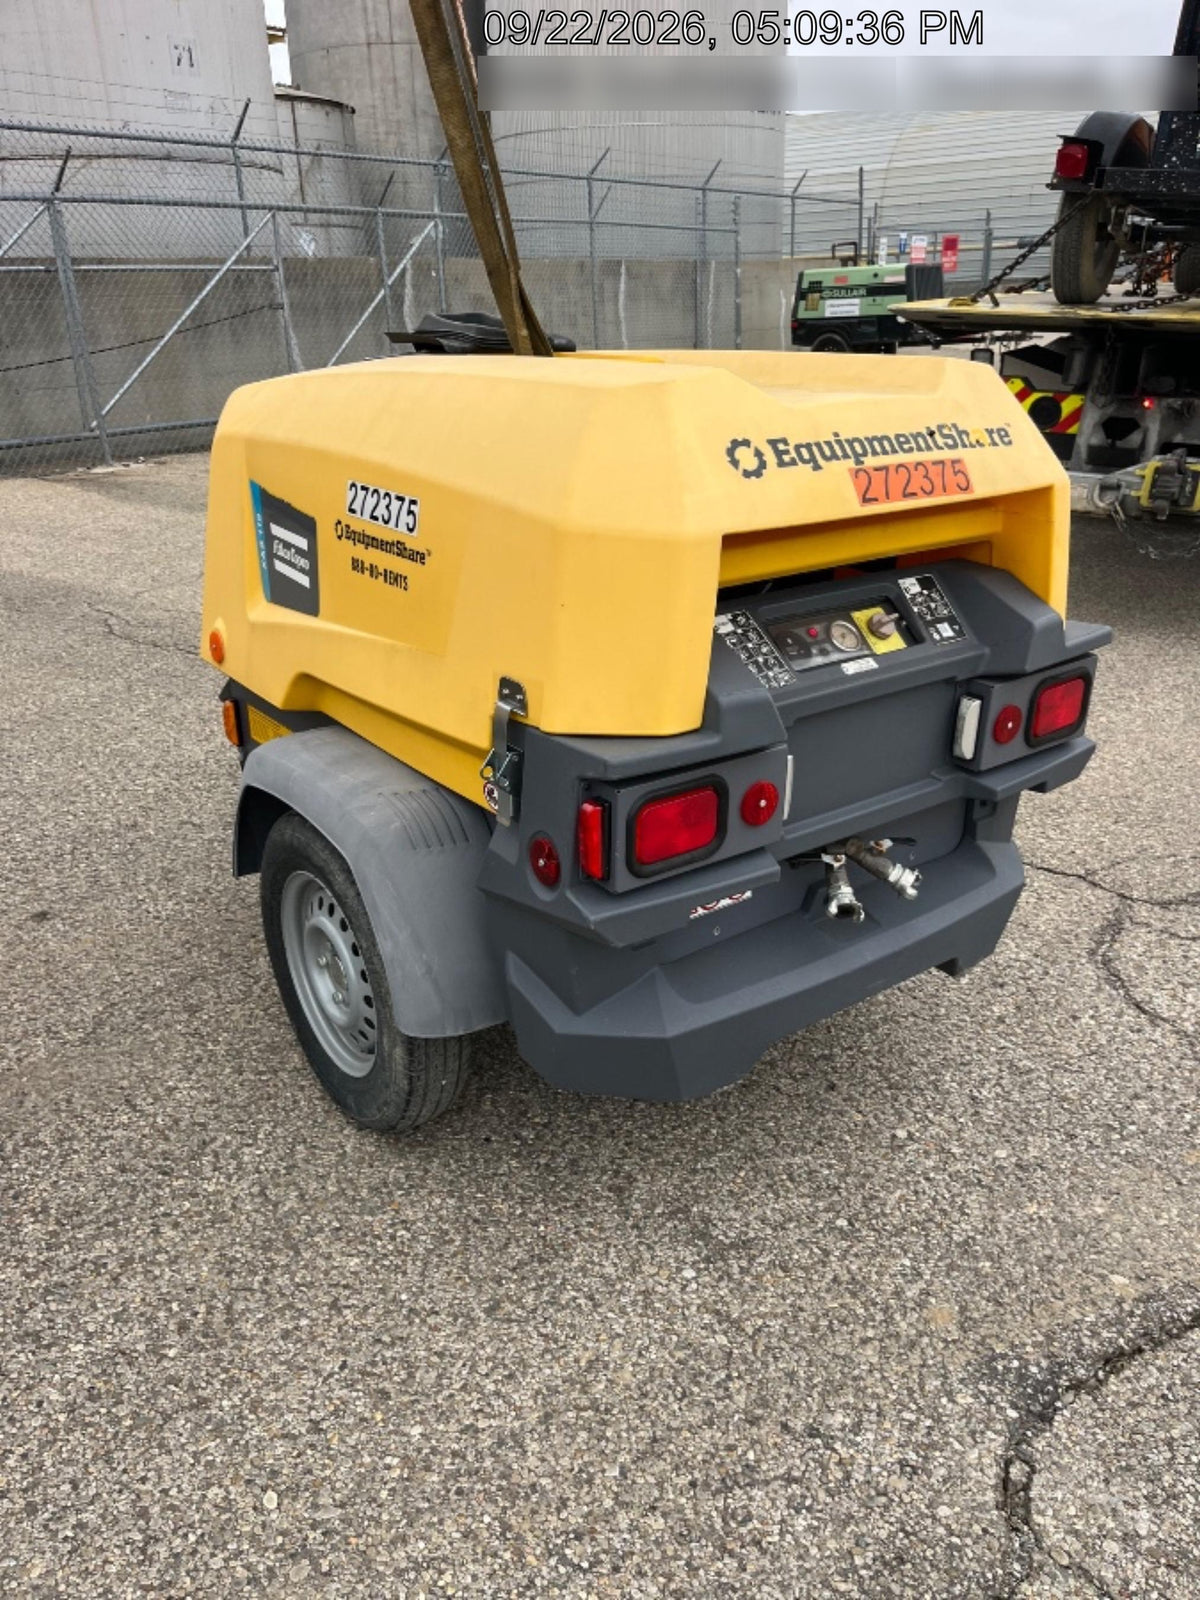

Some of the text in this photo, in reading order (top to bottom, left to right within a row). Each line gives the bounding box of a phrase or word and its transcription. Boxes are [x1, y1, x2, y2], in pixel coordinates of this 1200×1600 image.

[767, 422, 1013, 472] EquipmentShre
[854, 459, 970, 504] 272375
[347, 481, 418, 534] 272375
[344, 523, 426, 566] EquipmentShare
